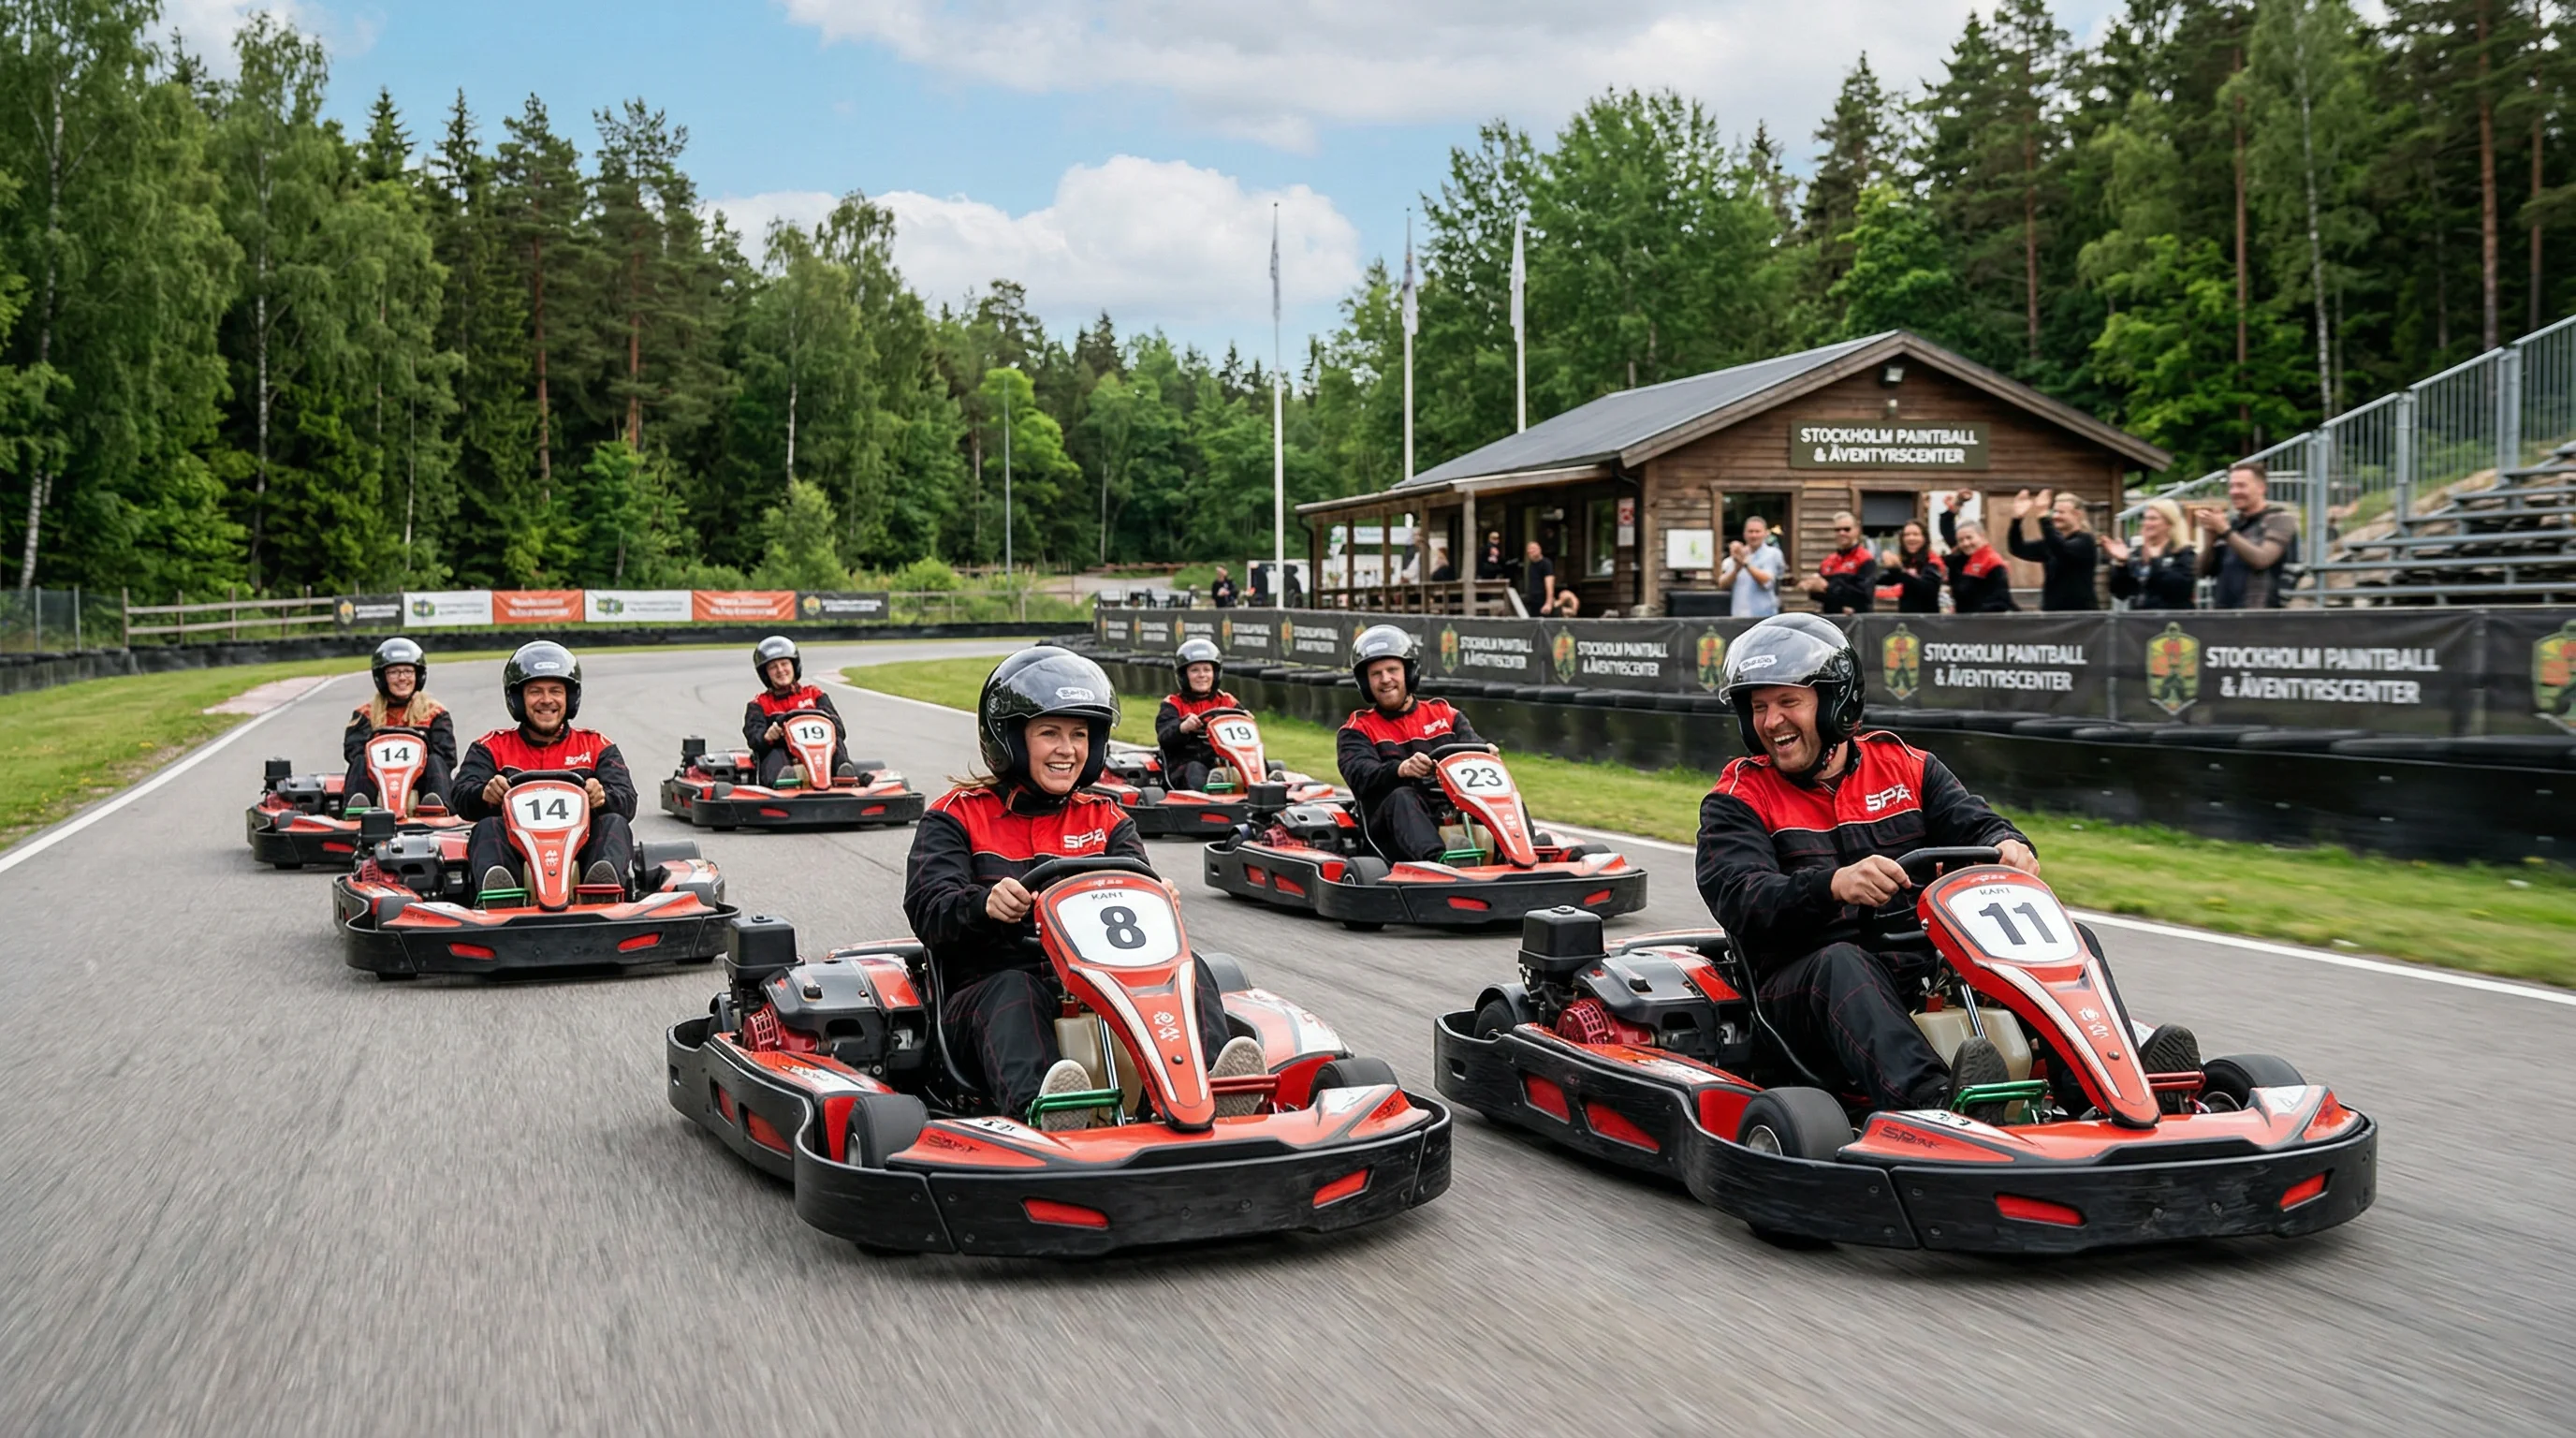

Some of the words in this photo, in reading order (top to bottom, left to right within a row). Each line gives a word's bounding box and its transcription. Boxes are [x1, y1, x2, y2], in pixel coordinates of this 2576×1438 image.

[1800, 427, 1893, 444] STOCKHOLM
[1896, 428, 1979, 446] PAINTBALL
[1813, 447, 1826, 462] &
[1828, 444, 1966, 463] ÄVENTYRSCENTER
[1924, 642, 2004, 663] STOCKHOLM
[2006, 644, 2088, 666] PAINTBALL
[2204, 646, 2320, 668] STOCKHOLM
[2324, 648, 2442, 672] PAINTBALL
[1934, 668, 1946, 686] &
[1947, 664, 2073, 691] ÄVENTYRSCENTER
[2219, 675, 2237, 697] &
[2238, 671, 2422, 704] ÄVENTYRSCENTER
[799, 726, 825, 740] 19
[1224, 726, 1251, 741] 19
[380, 747, 410, 762] 14
[1460, 767, 1502, 787] 23
[525, 798, 569, 821] 14
[1100, 905, 1147, 949] 8
[1978, 902, 2057, 946] 11
